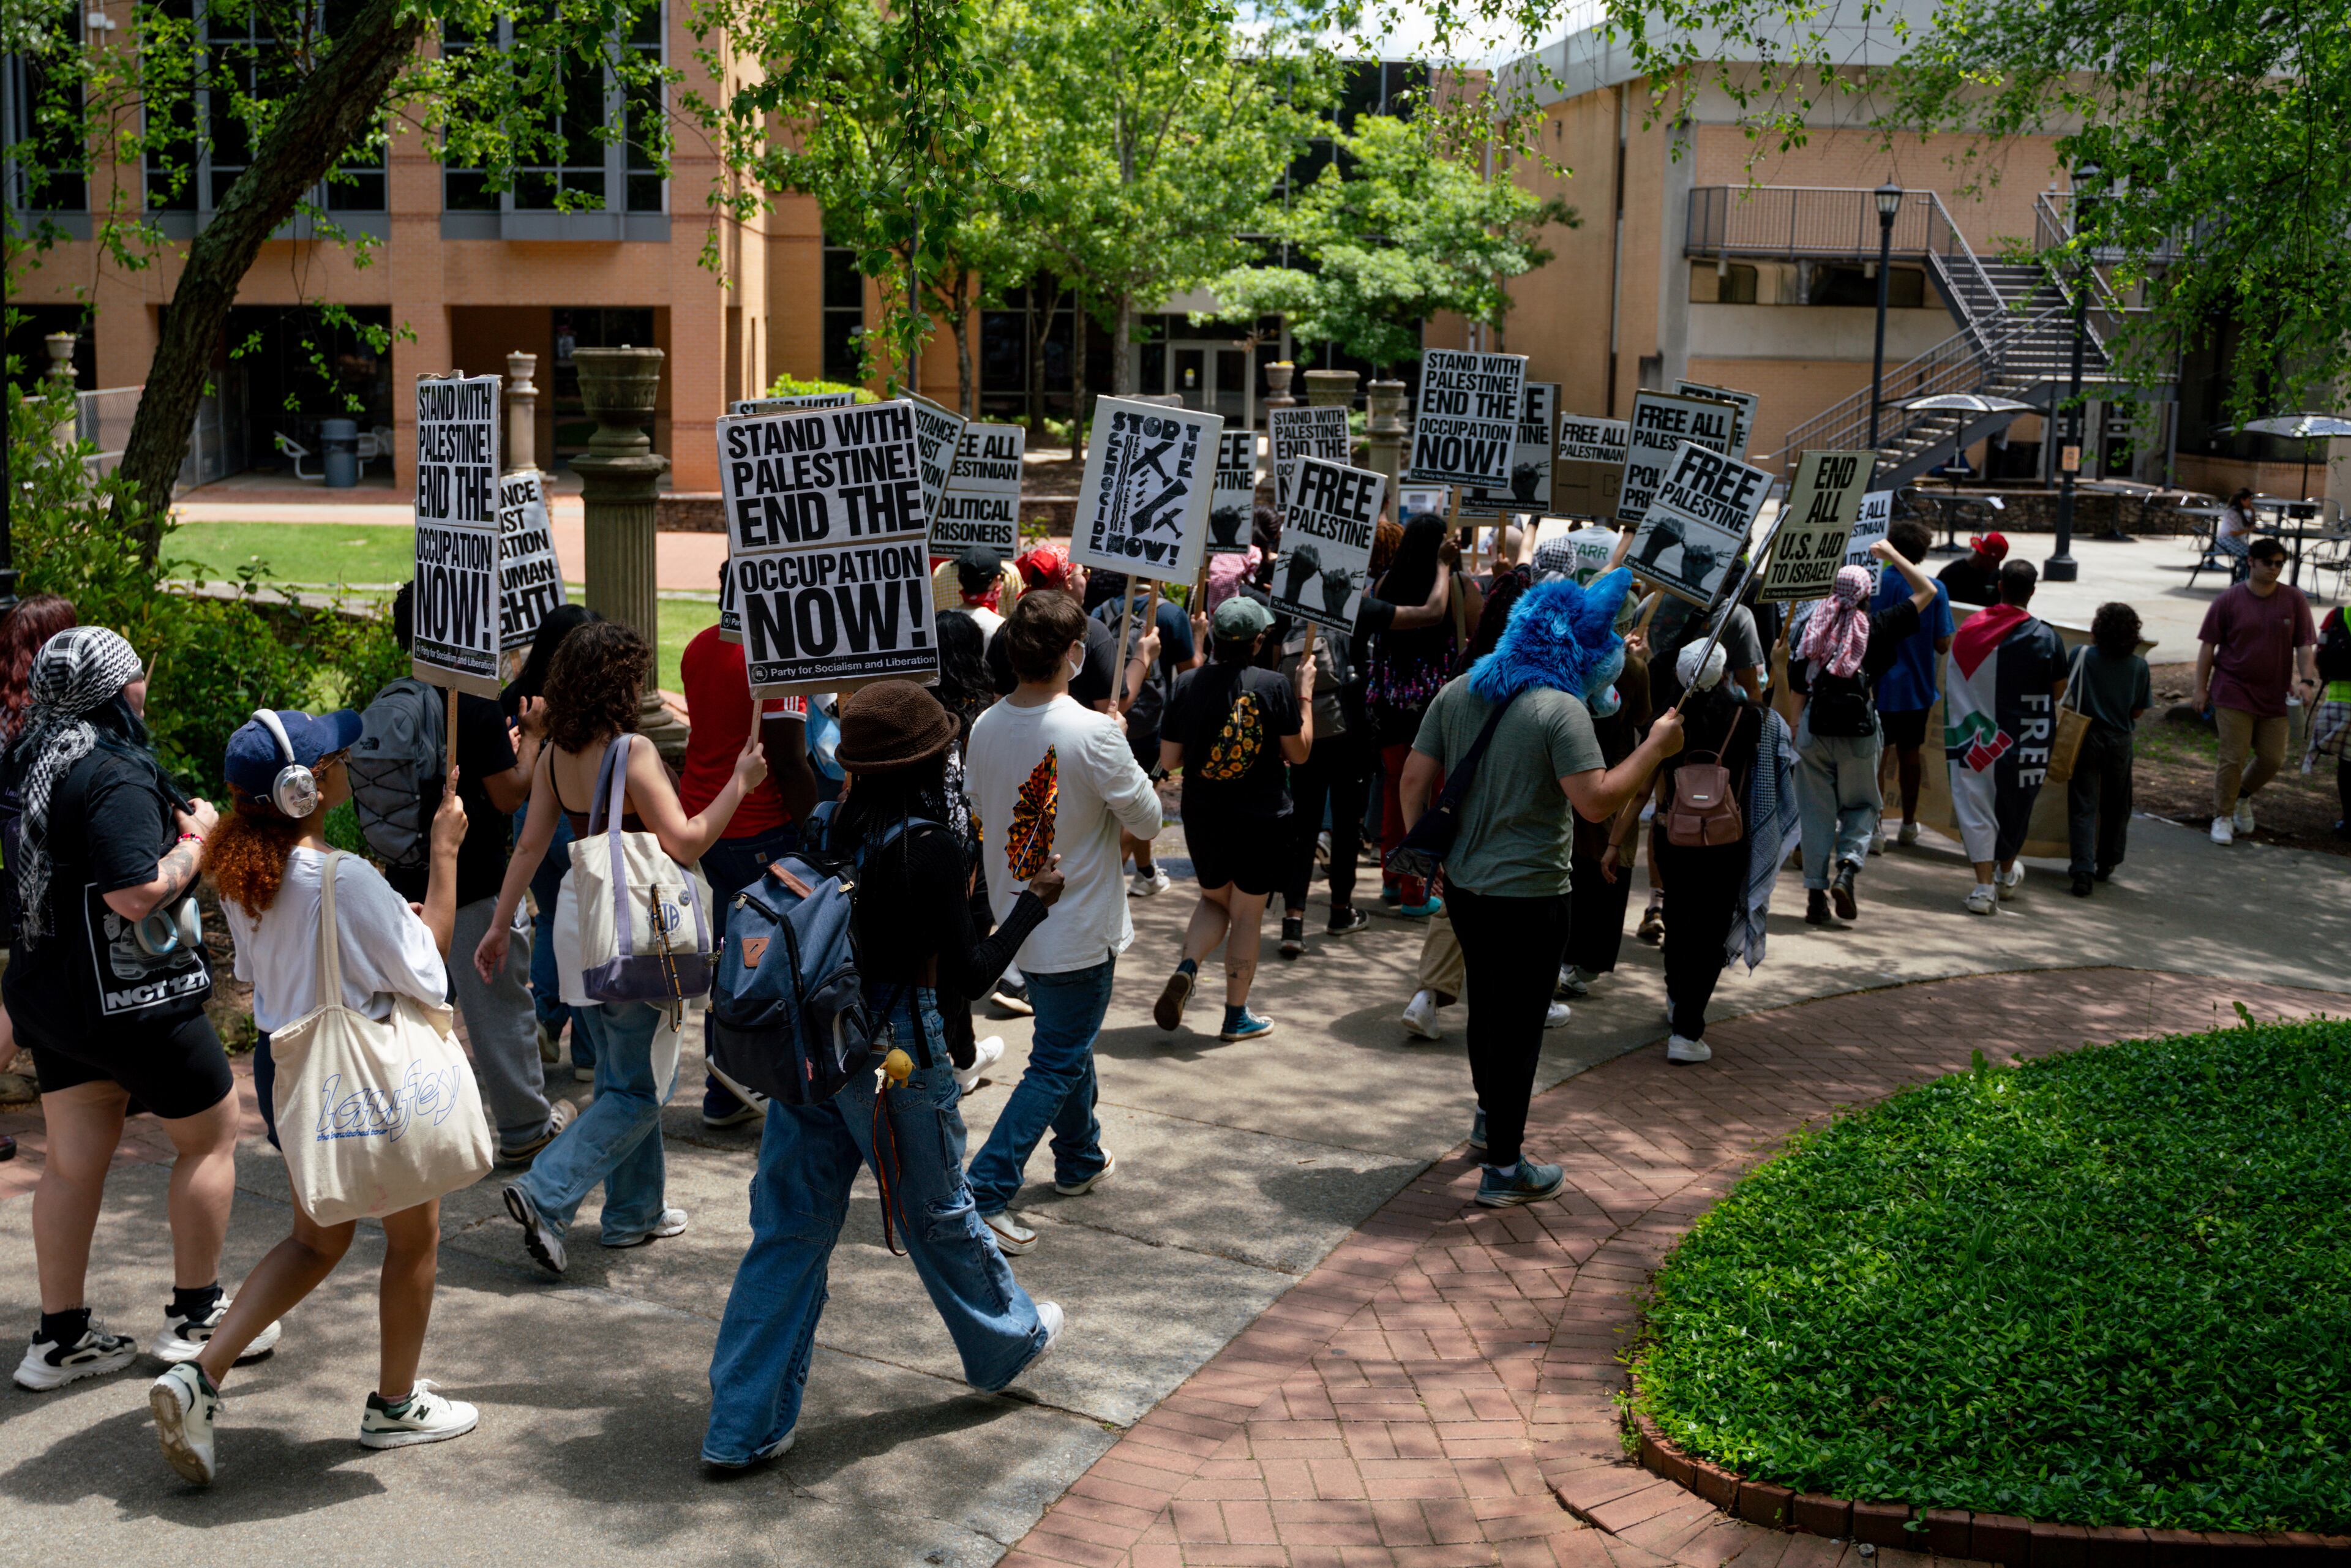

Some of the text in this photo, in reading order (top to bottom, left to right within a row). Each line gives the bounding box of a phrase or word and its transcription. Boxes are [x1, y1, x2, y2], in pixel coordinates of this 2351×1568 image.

[1428, 353, 1521, 375] STAND WITH
[1426, 370, 1518, 394] PALESTINE!
[419, 383, 491, 422] STAND WITH
[1274, 410, 1344, 425] STAND WITH
[1423, 389, 1518, 420] END THE
[728, 408, 913, 459] STAND WITH
[1111, 411, 1181, 441] STOP
[1276, 424, 1346, 440] PALESTINE!
[1419, 418, 1512, 441] OCCUPATION
[1562, 422, 1626, 446] FREE ALL
[1637, 404, 1689, 433] FREE
[1690, 413, 1727, 439] ALL
[419, 424, 492, 463] PALESTINE!
[983, 436, 1019, 460] ALL
[1176, 424, 1201, 479] THE
[1276, 438, 1346, 460] END THE
[1415, 435, 1507, 476] NOW!
[1559, 444, 1625, 462] PALESTINIAN
[732, 443, 917, 497] PALESTINE!
[1674, 447, 1763, 511] FREE
[1814, 456, 1857, 489] END
[419, 466, 494, 522] END THE
[1089, 432, 1123, 550] GENOCIDE
[1297, 460, 1377, 523] FREE
[1805, 492, 1840, 523] ALL
[736, 492, 830, 547] END
[839, 481, 924, 536] THE
[1659, 482, 1749, 534] PALESTINE
[1866, 500, 1886, 519] ALL
[934, 522, 1013, 544] RISONERS
[1287, 506, 1373, 550] PALESTINE
[417, 527, 492, 572] OCCUPATION
[1106, 533, 1180, 566] NOW!
[1779, 532, 1845, 560] U.S. AID
[740, 545, 924, 592] OCCUPATION
[1634, 561, 1646, 571] Party
[1771, 560, 1835, 583] TO ISRAEL!
[417, 563, 491, 650] NOW!
[744, 580, 927, 662] NOW!
[1281, 602, 1292, 612] Party
[1301, 608, 1322, 620] Socialism
[1332, 618, 1351, 629] Liberation
[437, 650, 457, 662] Socialism
[468, 656, 496, 670] Liberation
[771, 655, 936, 677] Party for Socialism and Liberation
[2019, 694, 2050, 787] FREE
[106, 970, 205, 1009] NCT 127
[316, 1059, 460, 1142] laufey
[317, 1133, 329, 1141] the
[331, 1128, 370, 1139] bewitched
[413, 1405, 430, 1420] N
